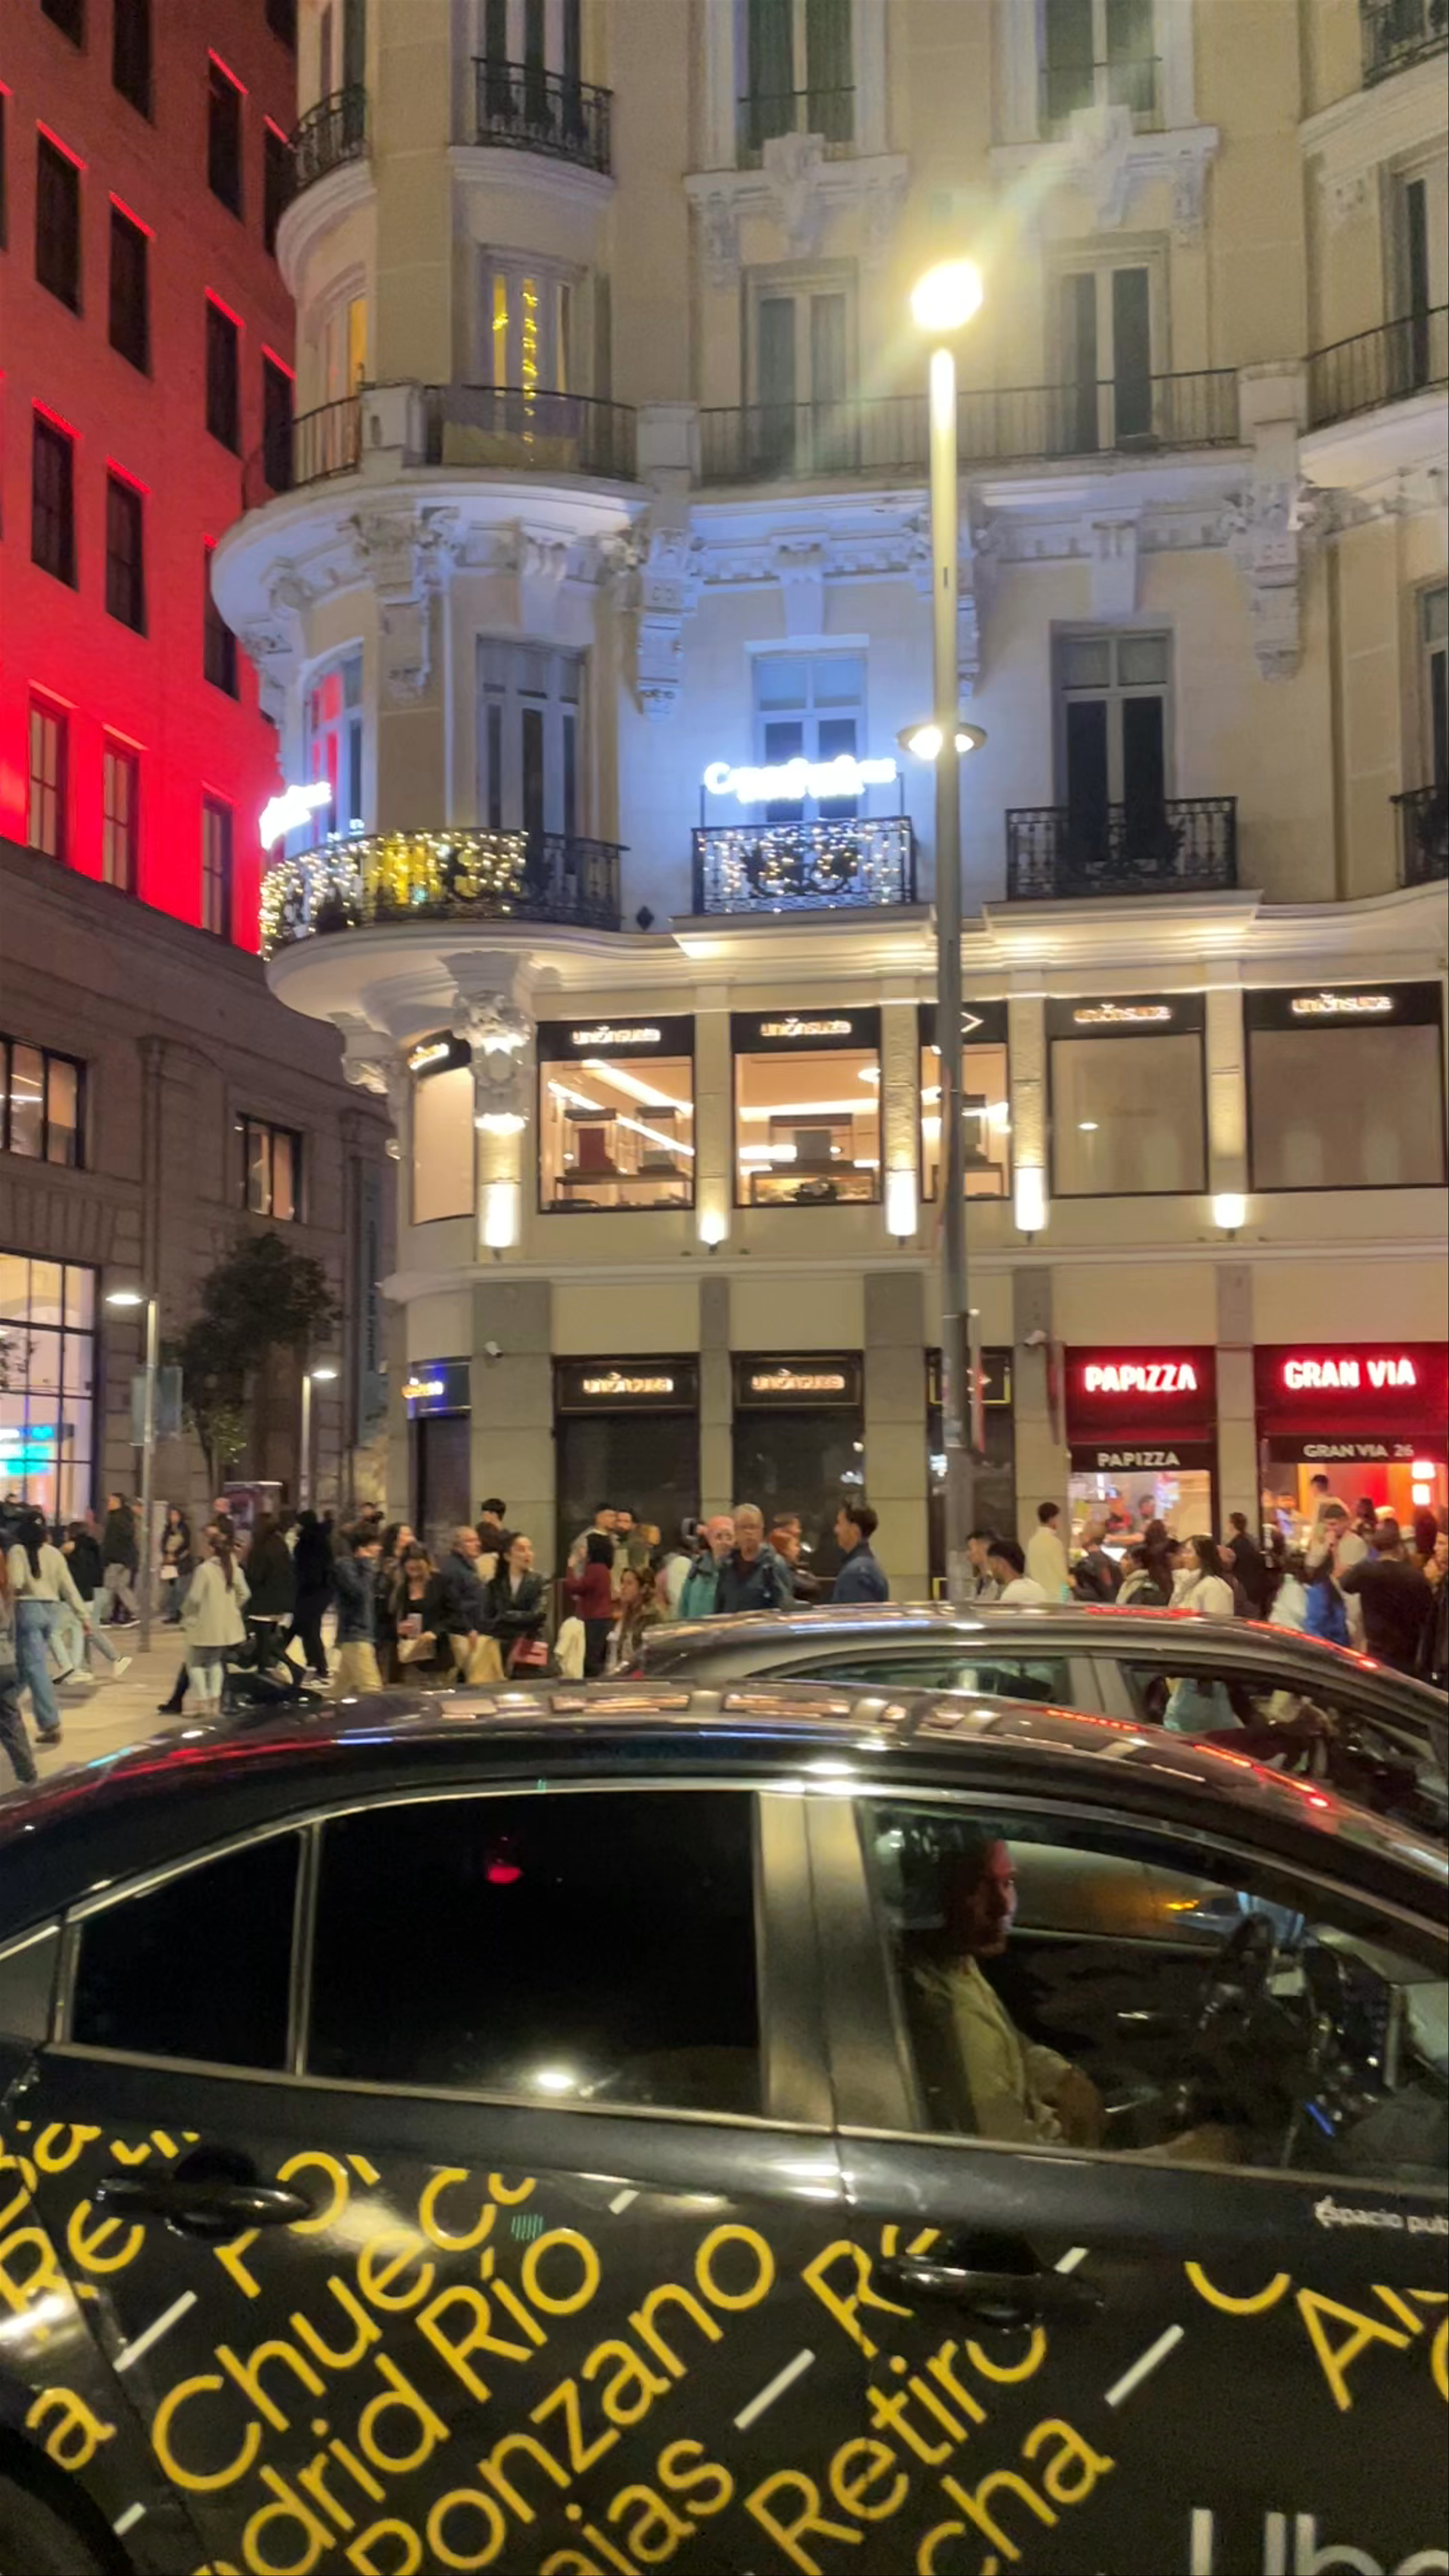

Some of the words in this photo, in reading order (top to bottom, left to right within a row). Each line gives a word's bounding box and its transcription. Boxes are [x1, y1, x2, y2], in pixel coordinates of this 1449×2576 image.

[1085, 1364, 1197, 1392] PAPIZZA
[1284, 1361, 1360, 1389] GRAN
[1367, 1358, 1416, 1388] VIA
[1097, 1452, 1180, 1467] PAPIZZA
[1303, 1444, 1355, 1457] GRAN
[1355, 1444, 1389, 1457] VIA
[193, 2354, 449, 2576] drid
[415, 2228, 601, 2402] Río
